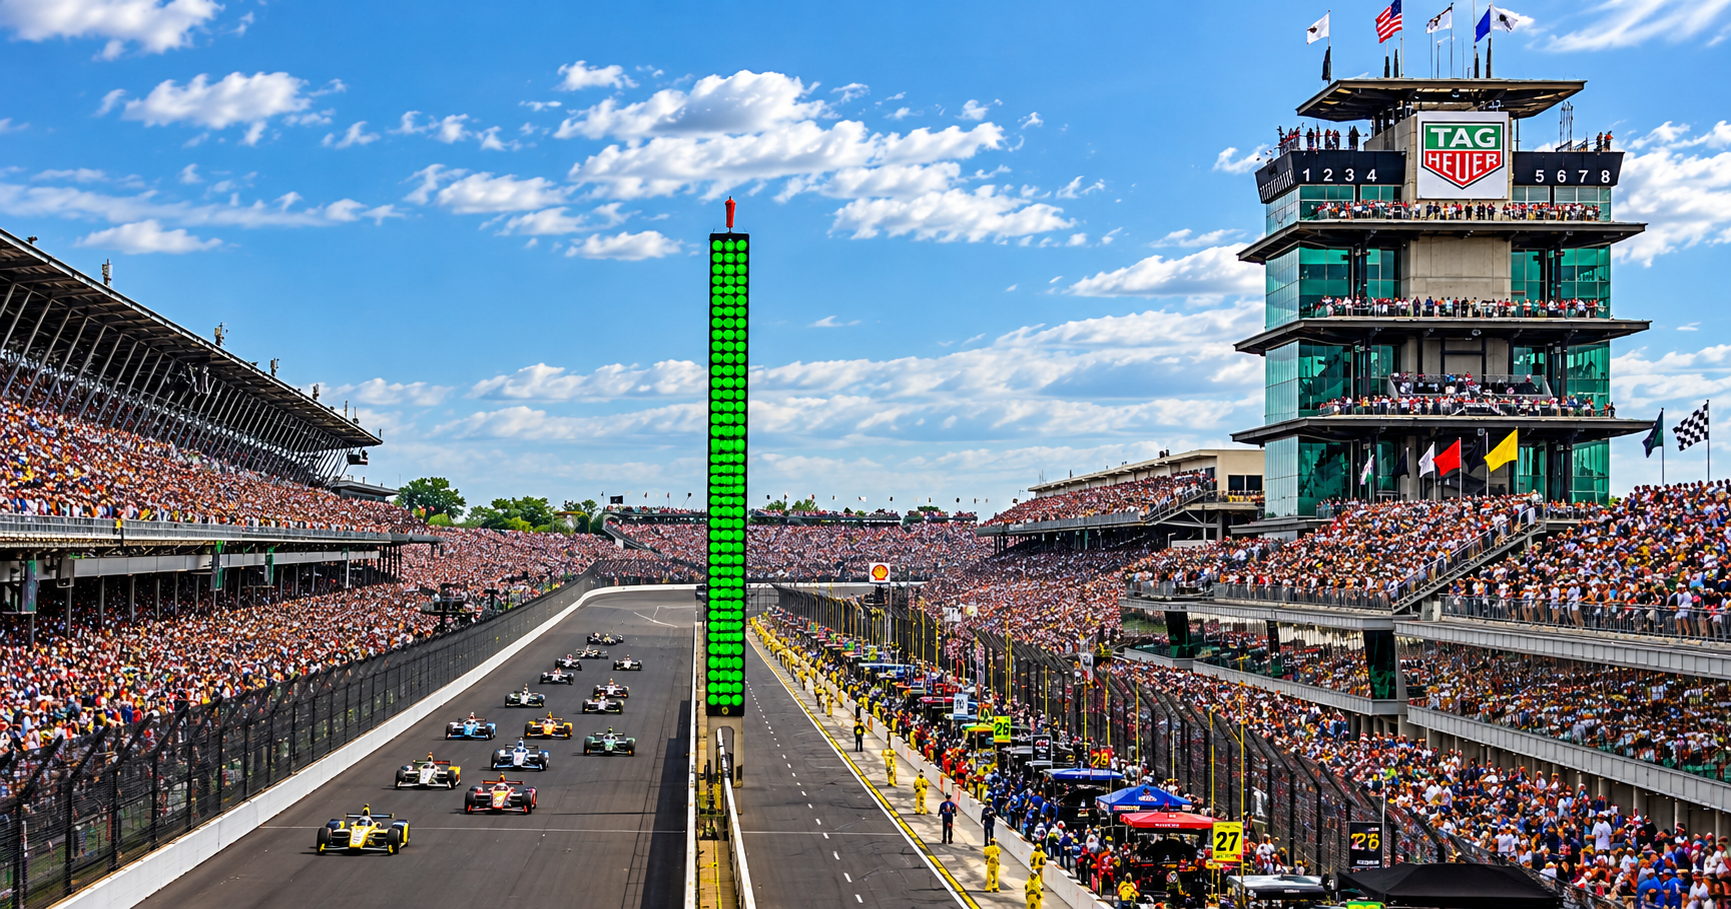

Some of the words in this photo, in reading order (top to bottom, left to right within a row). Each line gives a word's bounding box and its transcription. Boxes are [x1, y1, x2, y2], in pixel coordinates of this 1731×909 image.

[1430, 128, 1495, 148] TAG
[1302, 168, 1310, 182] 1
[1323, 168, 1333, 182] 2
[1344, 168, 1355, 182] 3
[1366, 168, 1377, 182] 4
[1428, 153, 1497, 182] HEUER
[1535, 169, 1545, 183] 5
[1557, 169, 1567, 183] 6
[1578, 169, 1589, 183] 7
[1601, 169, 1611, 183] 8
[994, 722, 1010, 736] 26
[1215, 831, 1240, 851] 27
